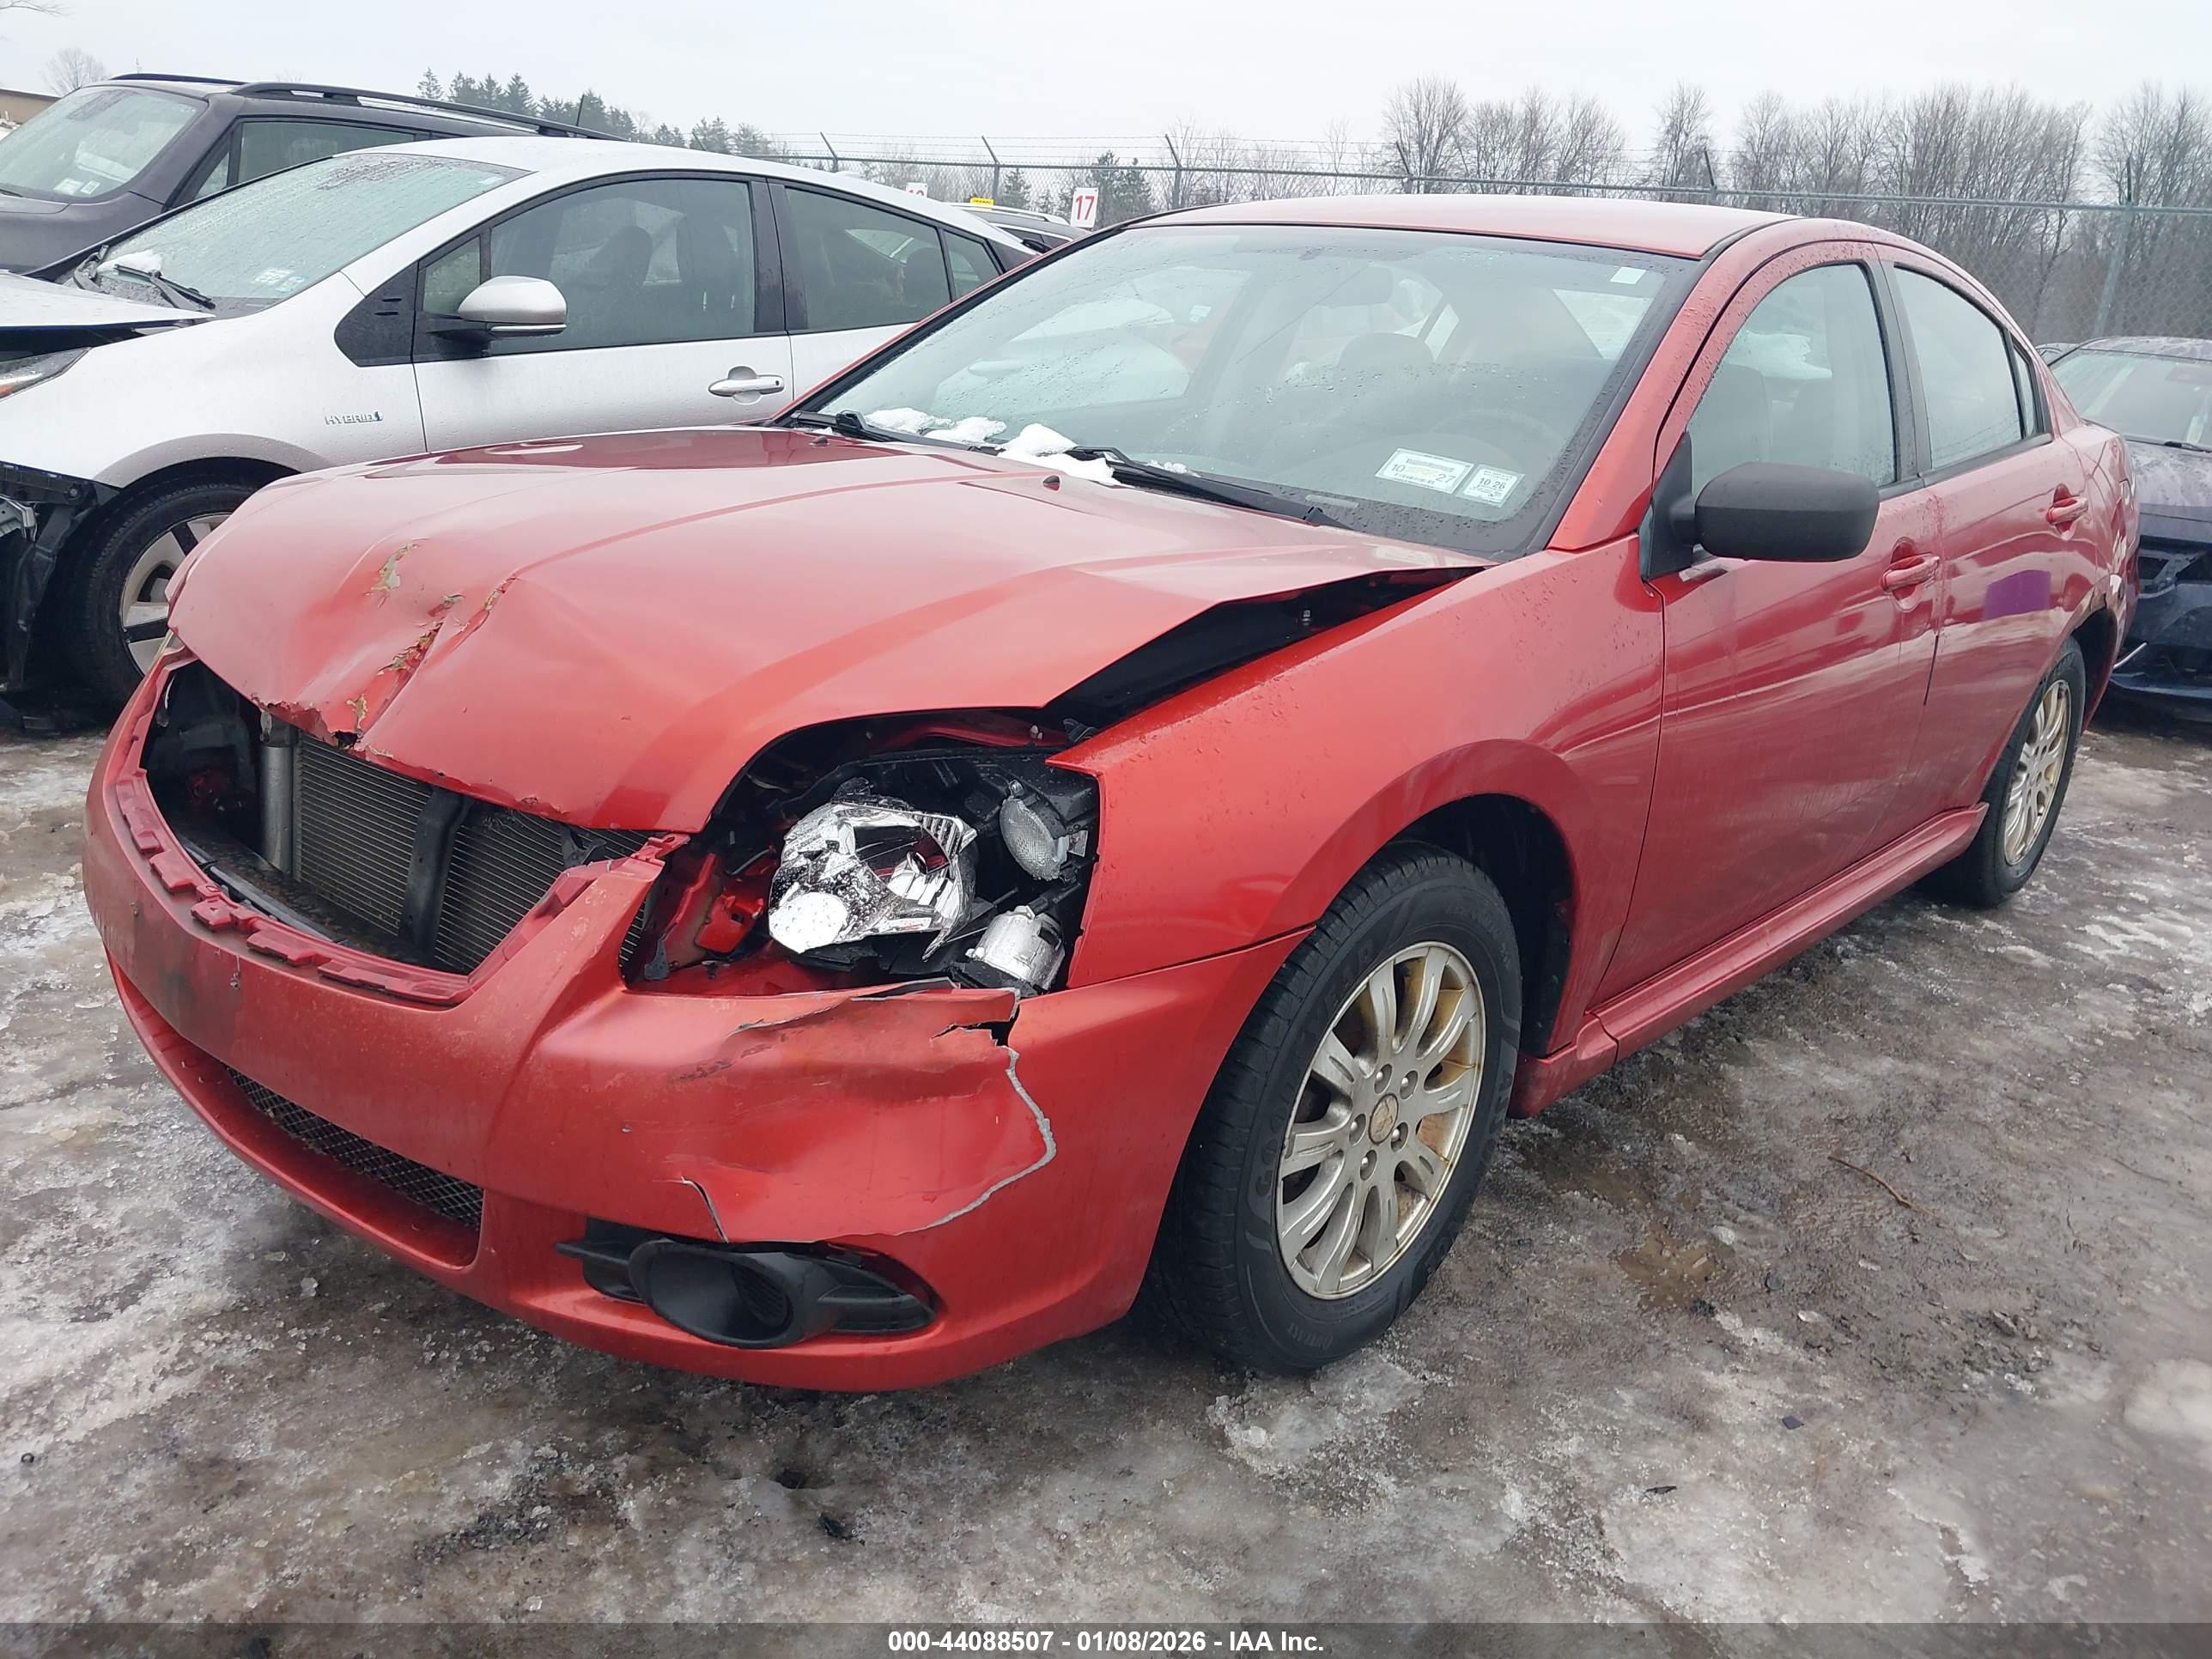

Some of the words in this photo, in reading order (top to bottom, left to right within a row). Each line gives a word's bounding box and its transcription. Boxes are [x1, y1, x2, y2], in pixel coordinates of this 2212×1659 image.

[1076, 195, 1095, 220] 17
[324, 414, 373, 424] HYBRID
[1392, 464, 1407, 473] 10
[1436, 473, 1457, 483] 27
[1480, 477, 1491, 486] 10
[1492, 481, 1506, 489] 26
